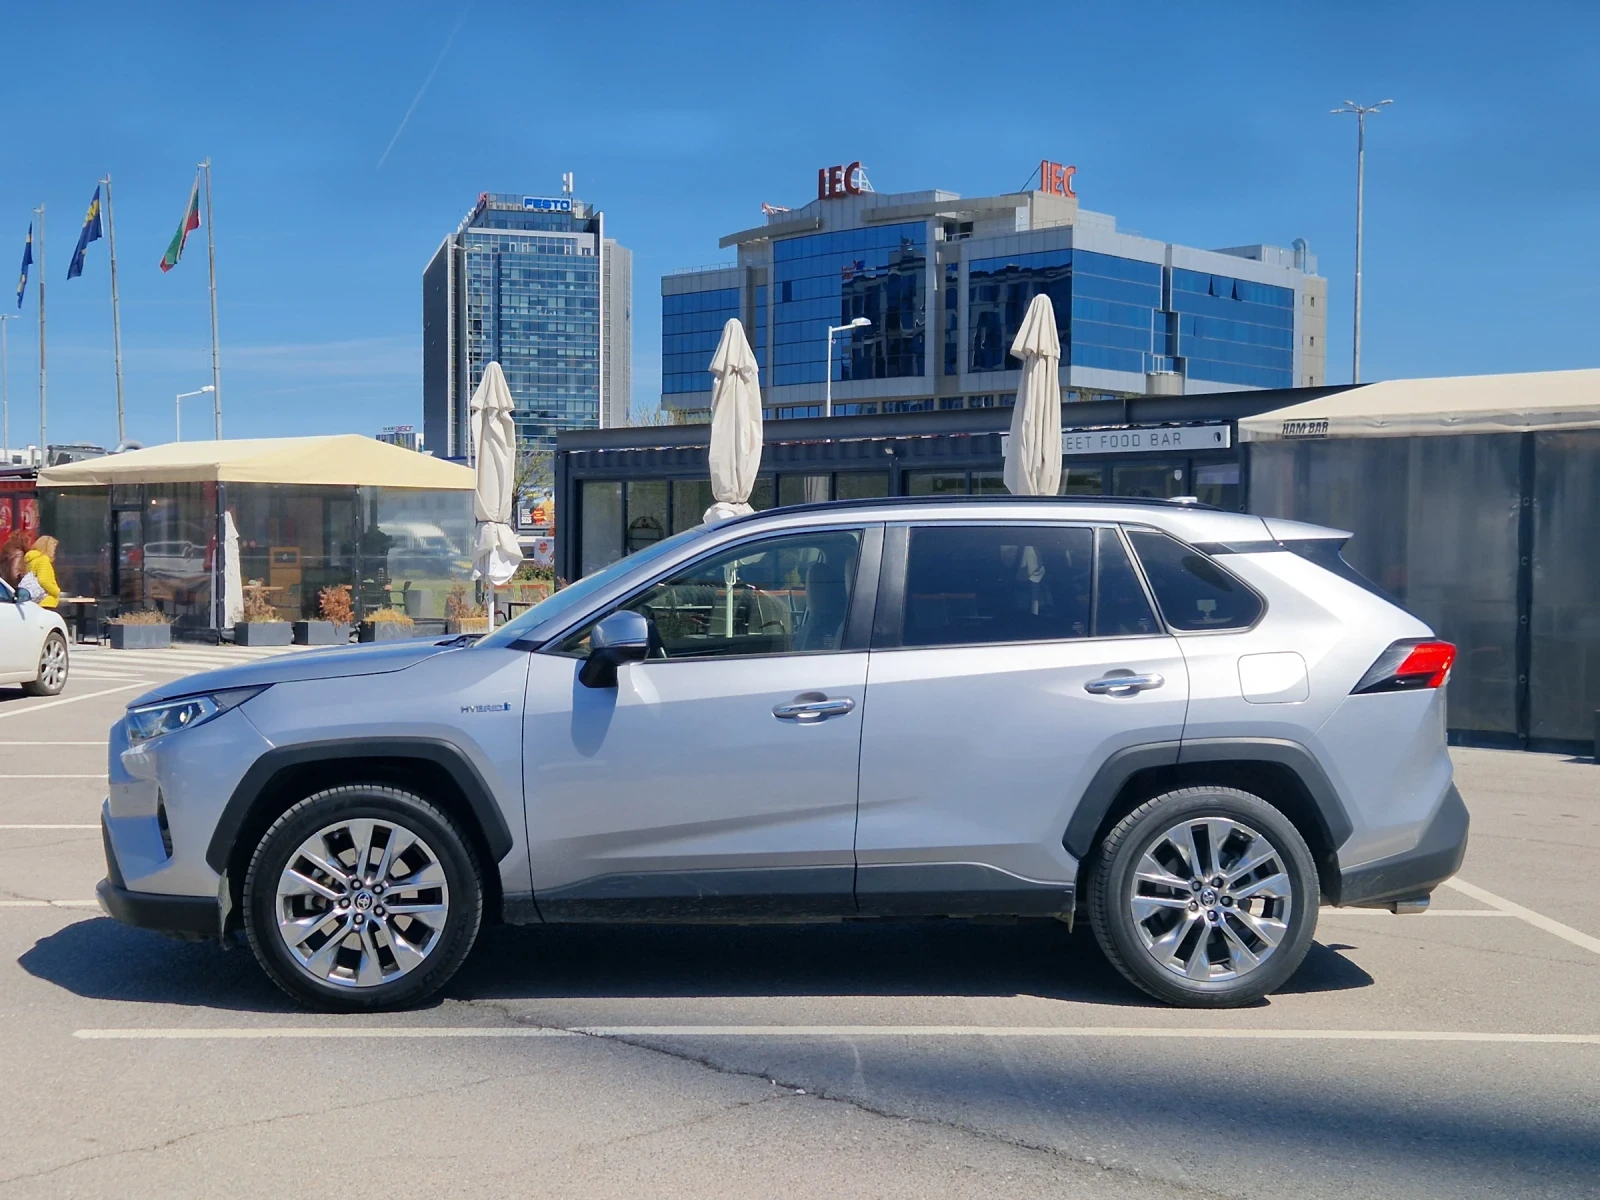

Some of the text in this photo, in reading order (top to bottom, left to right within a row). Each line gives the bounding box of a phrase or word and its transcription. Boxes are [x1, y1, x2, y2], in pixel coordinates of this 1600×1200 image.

[818, 161, 862, 200] IEC
[1041, 160, 1076, 198] IEC
[525, 199, 570, 210] FESTO
[1282, 421, 1329, 434] HAM BAR
[1100, 433, 1141, 448] FOOD
[1150, 432, 1182, 446] BAR
[461, 704, 503, 713] HYBRID
